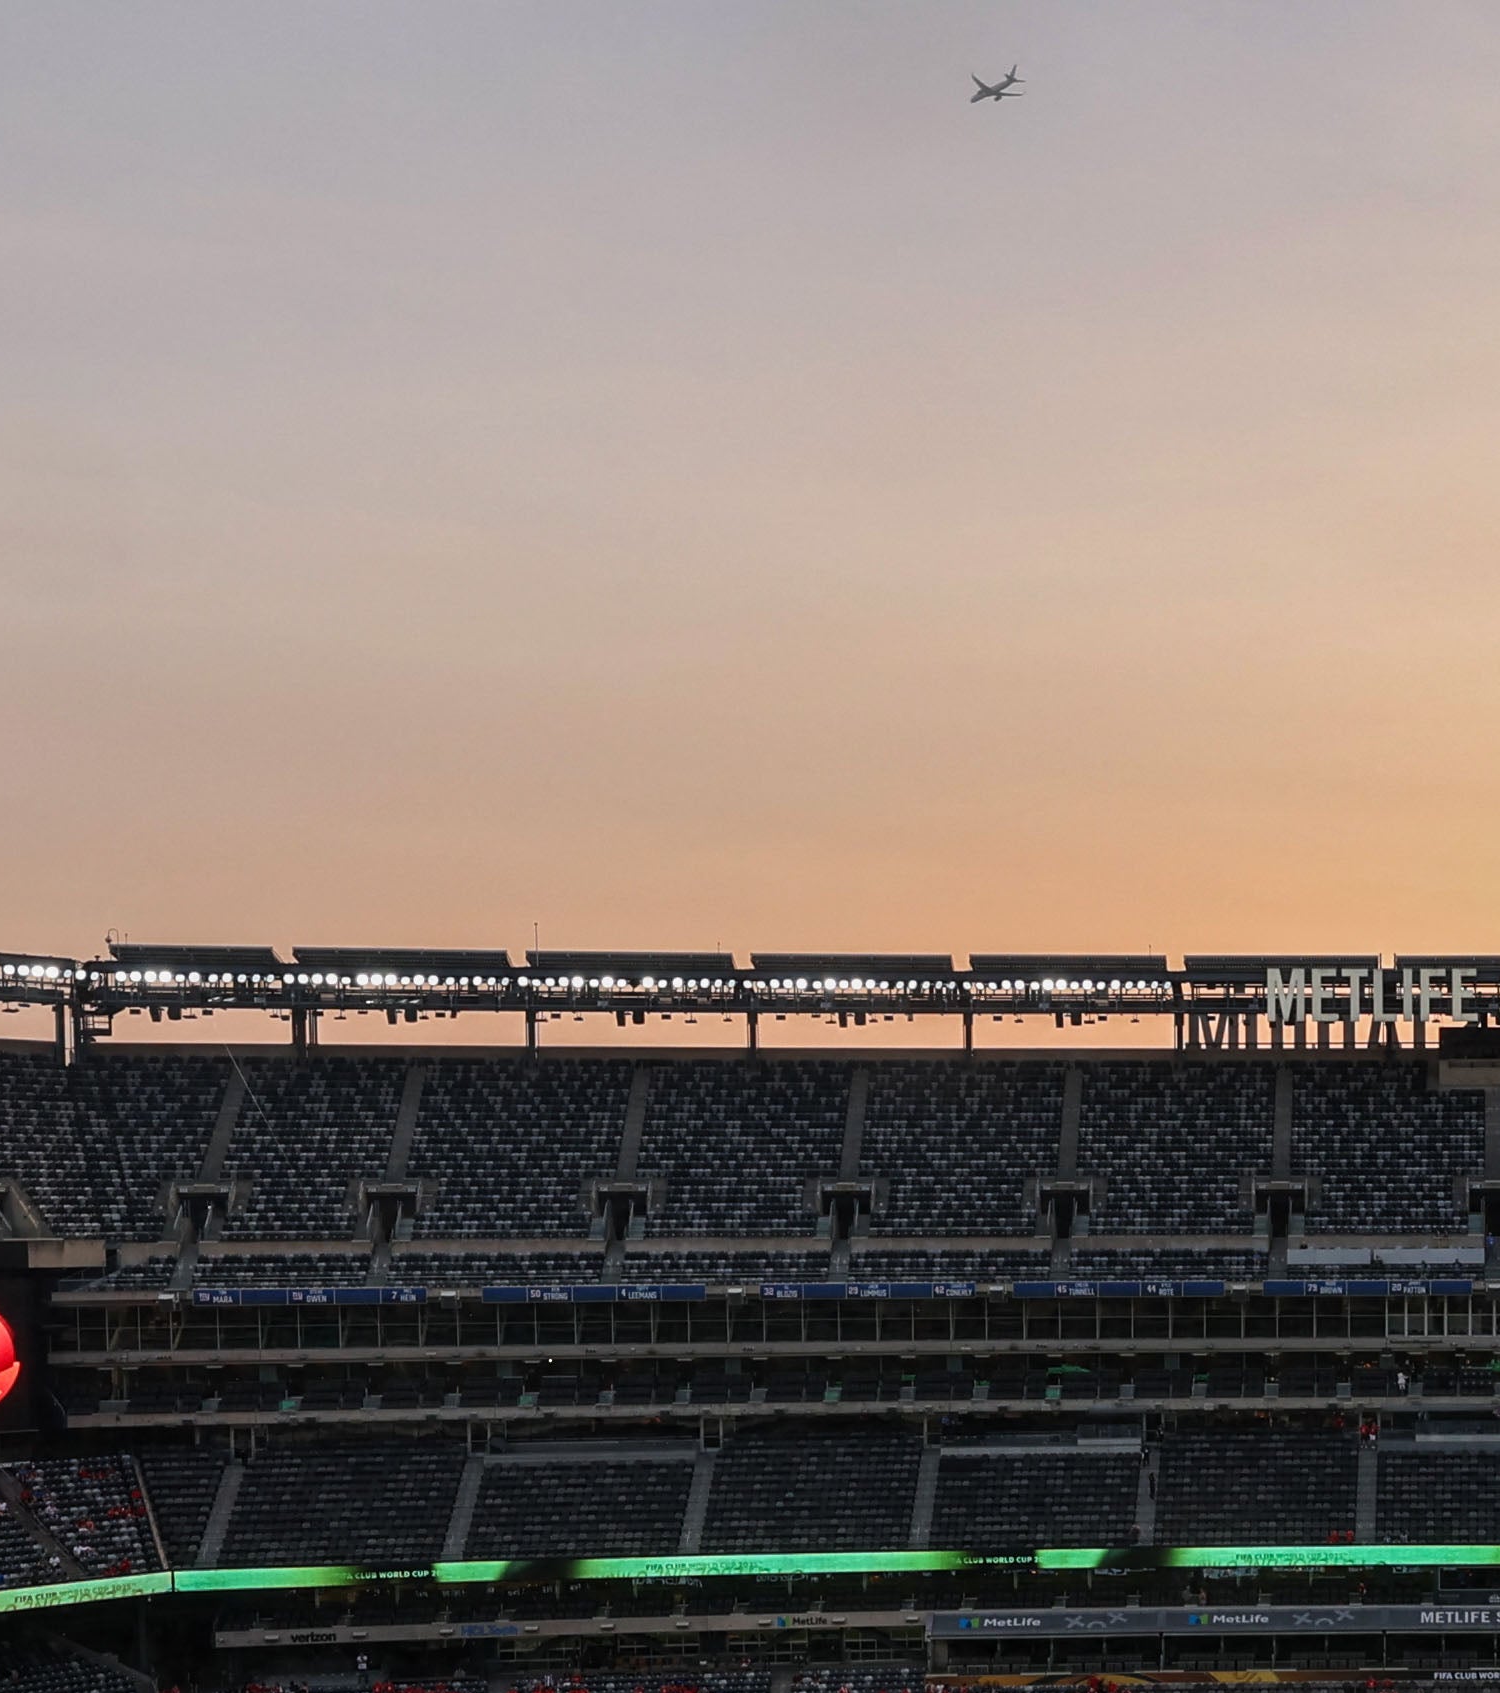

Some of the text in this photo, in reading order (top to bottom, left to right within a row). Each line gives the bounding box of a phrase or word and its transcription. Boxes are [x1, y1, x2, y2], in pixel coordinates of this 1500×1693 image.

[1266, 967, 1481, 1022] METLIFE
[391, 1291, 398, 1300] 7
[530, 1290, 568, 1300] 50 STRONG
[985, 1556, 1015, 1564] WORLD
[1016, 1555, 1033, 1564] CUP
[378, 1570, 410, 1580] WORLD
[411, 1569, 427, 1579] CUP
[13, 1592, 58, 1603] FIFA CLUB
[792, 1617, 828, 1625] MetLife
[983, 1618, 1042, 1627] MetLife
[1212, 1614, 1270, 1624] MetLife
[1419, 1611, 1490, 1624] METLIFE
[290, 1631, 337, 1643] verizon
[1433, 1672, 1453, 1680] FIFA
[1454, 1672, 1477, 1680] CLUB
